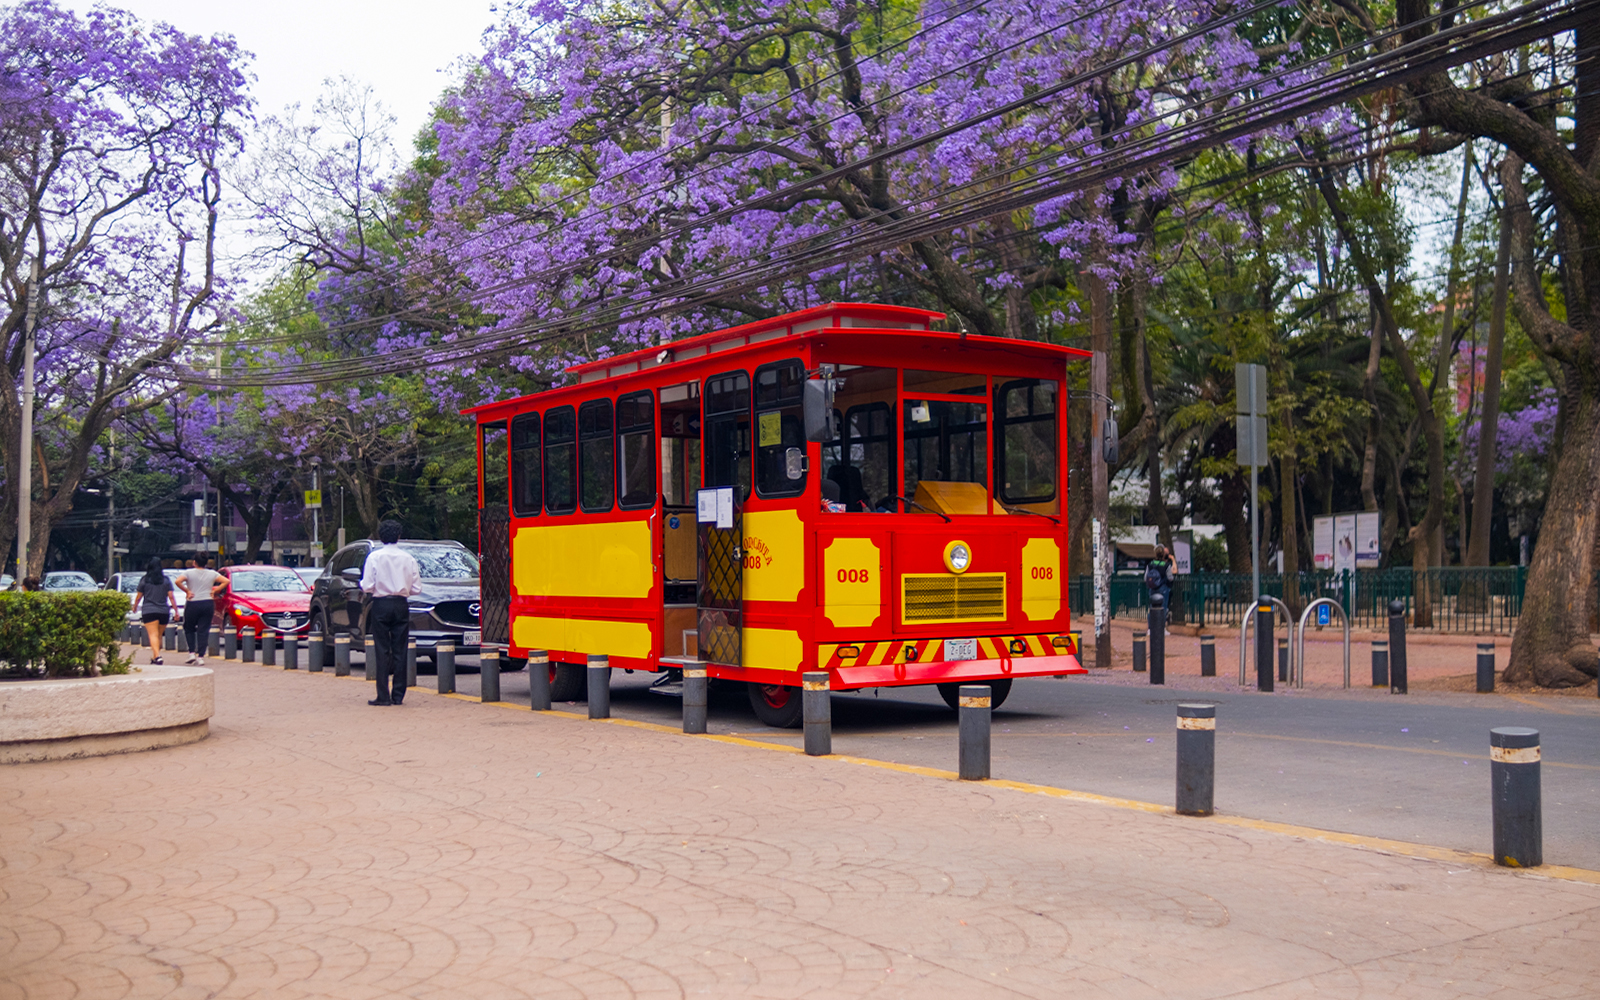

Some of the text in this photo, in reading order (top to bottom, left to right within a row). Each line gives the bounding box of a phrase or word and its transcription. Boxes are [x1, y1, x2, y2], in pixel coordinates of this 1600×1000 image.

[743, 555, 761, 570] 008
[837, 568, 869, 584] 008
[1031, 566, 1053, 580] 008
